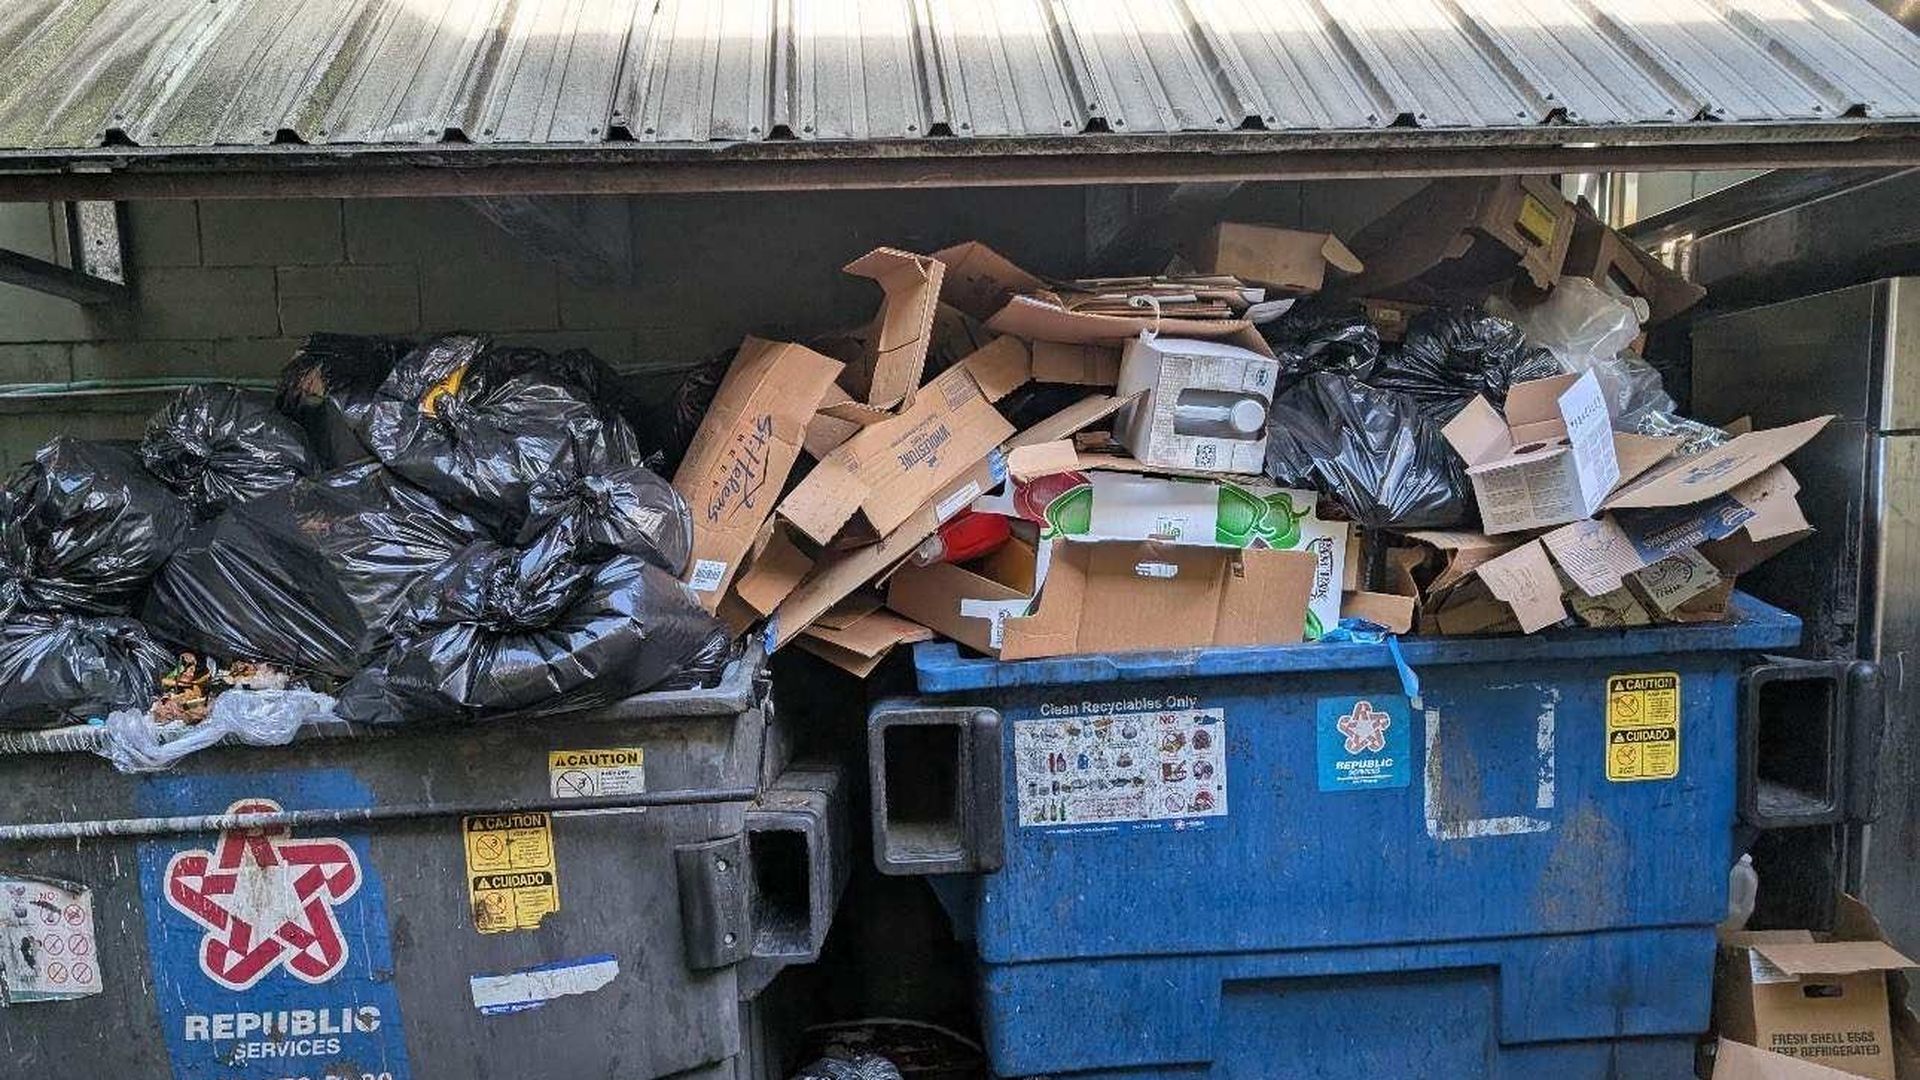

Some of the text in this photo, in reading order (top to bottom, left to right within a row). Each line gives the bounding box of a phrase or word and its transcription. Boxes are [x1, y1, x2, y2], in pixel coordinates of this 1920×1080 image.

[708, 446, 759, 522] Helens
[1626, 679, 1673, 690] CAUTION
[1040, 694, 1198, 716] Clean Recyclables Only
[1626, 730, 1669, 741] CUIDADO
[567, 753, 638, 766] CAUTION
[1335, 758, 1394, 770] REPUBLIC
[492, 873, 545, 888] CUIDADO
[185, 1006, 381, 1041] REPUBLIC
[1772, 1031, 1875, 1045] FRESH SHELL EGGS
[234, 1038, 341, 1060] SERVICES
[1801, 1044, 1880, 1056] REFRIGERATED
